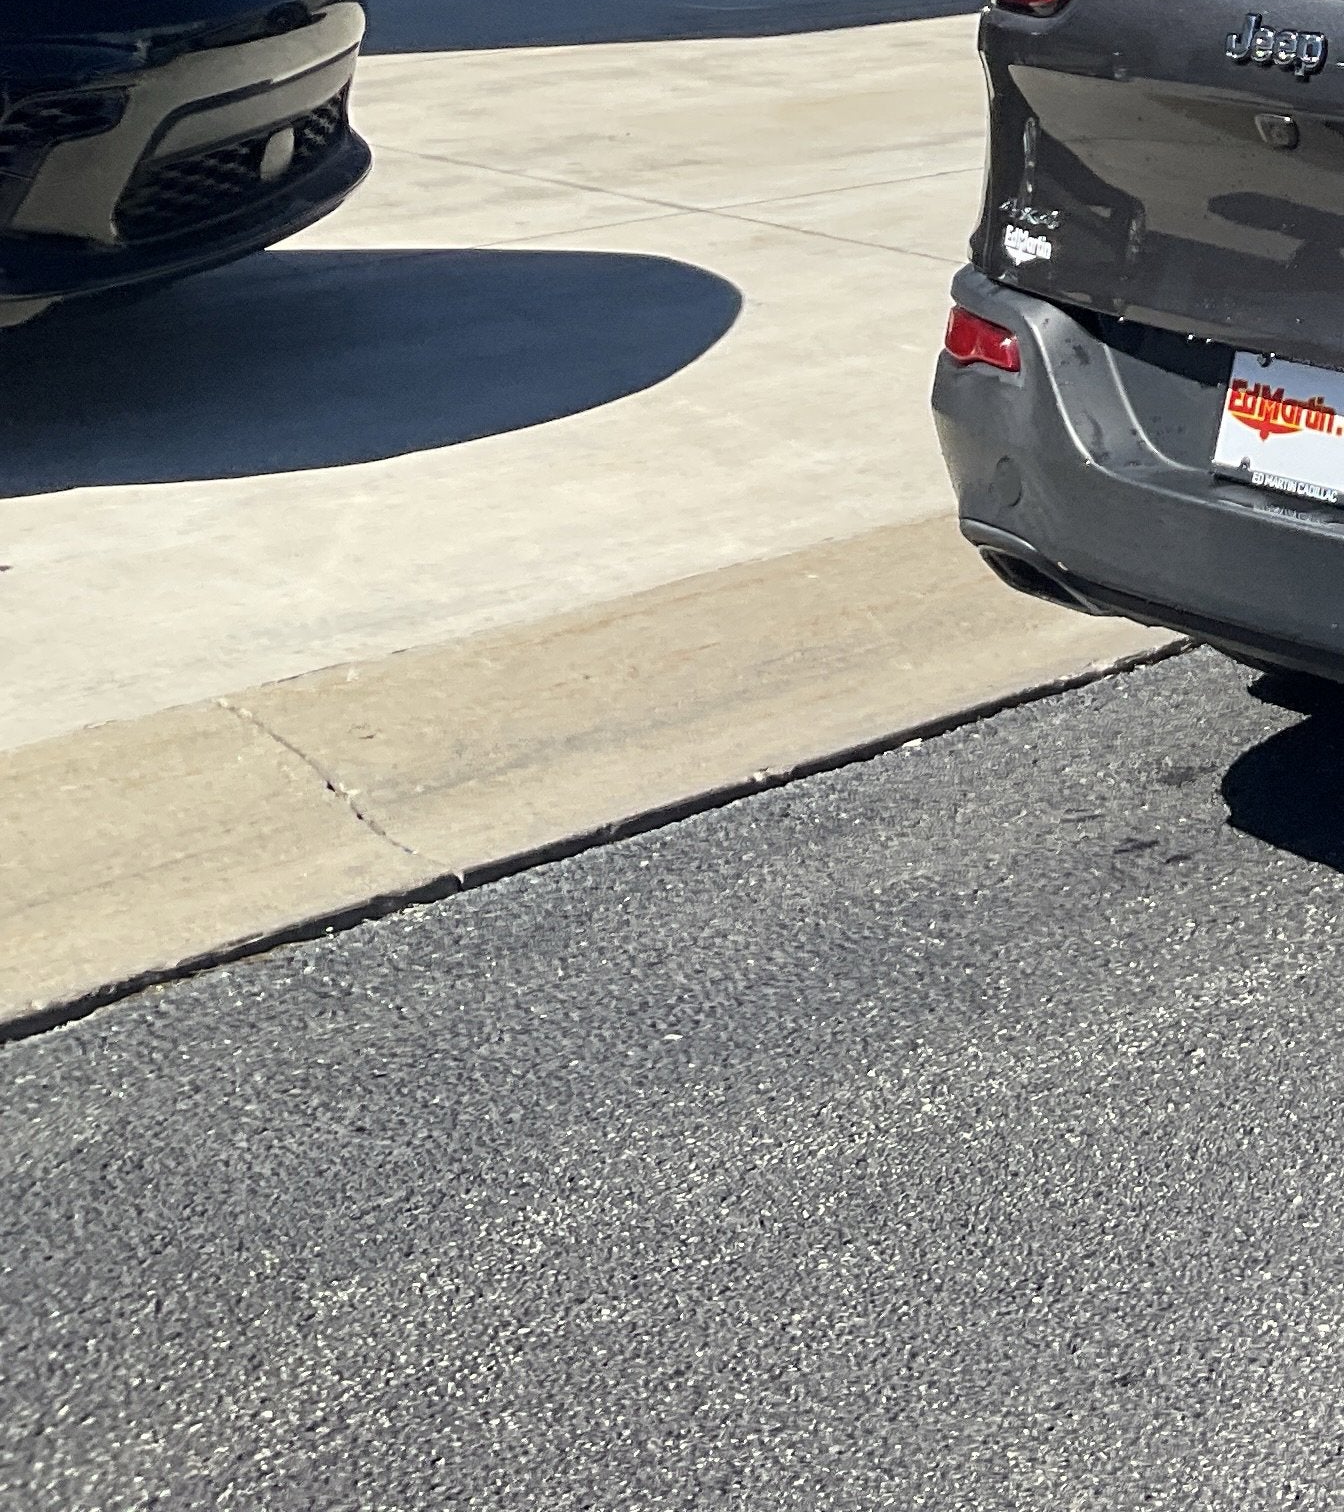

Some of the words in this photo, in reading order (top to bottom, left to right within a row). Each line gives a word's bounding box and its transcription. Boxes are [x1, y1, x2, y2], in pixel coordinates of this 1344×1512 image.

[1225, 13, 1328, 82] Jeep
[1251, 471, 1265, 486] ED
[1264, 473, 1297, 493] MARTIN
[1297, 482, 1338, 503] CADILLAC
